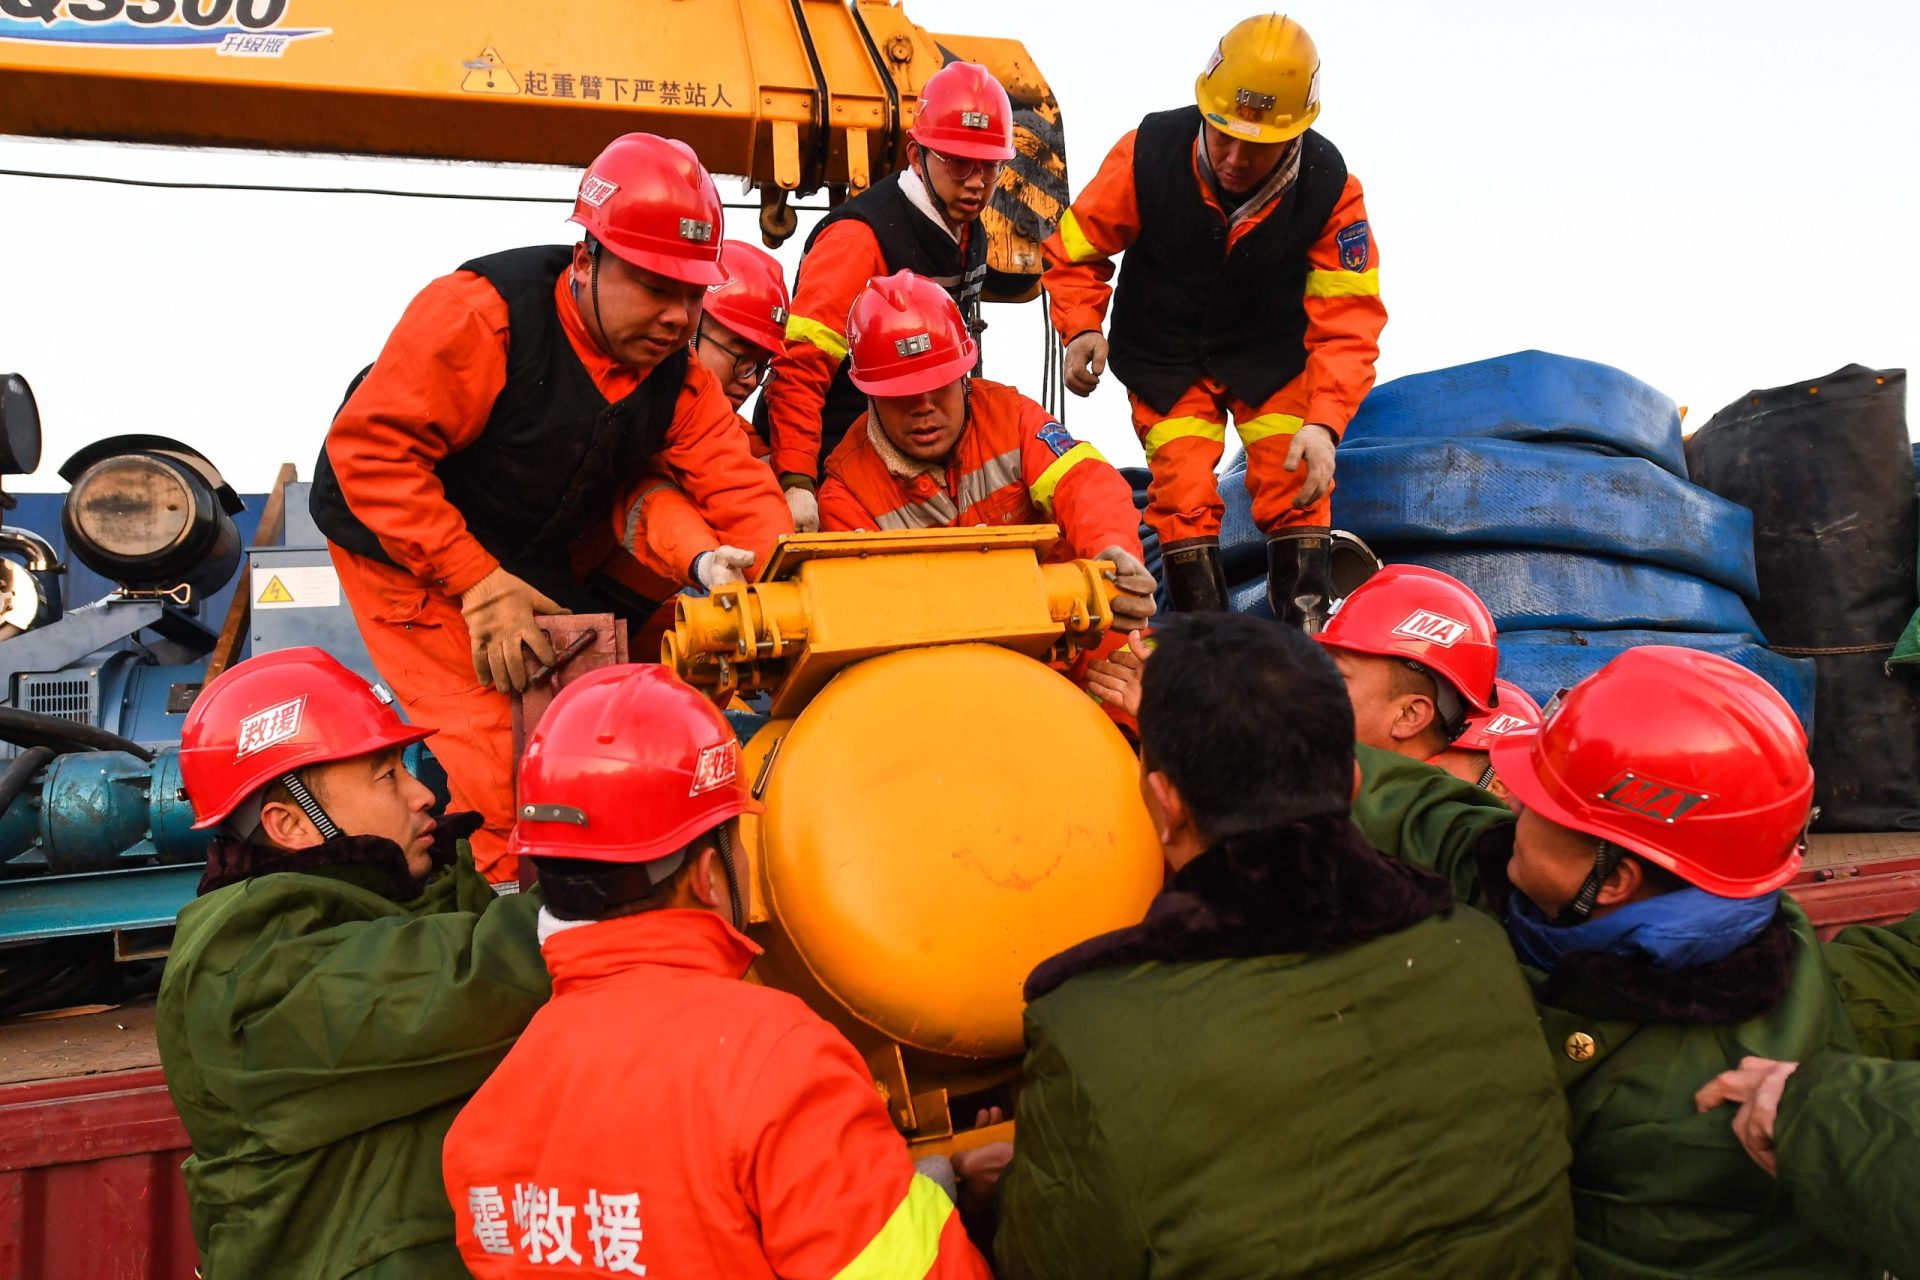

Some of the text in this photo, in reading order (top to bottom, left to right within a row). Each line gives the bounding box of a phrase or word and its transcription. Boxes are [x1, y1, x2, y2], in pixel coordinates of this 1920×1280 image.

[221, 36, 286, 52] 升级版
[524, 70, 733, 108] 起重臂下严禁站人
[1409, 616, 1455, 641] MA
[241, 703, 297, 750] 救援
[1610, 779, 1686, 818] MA
